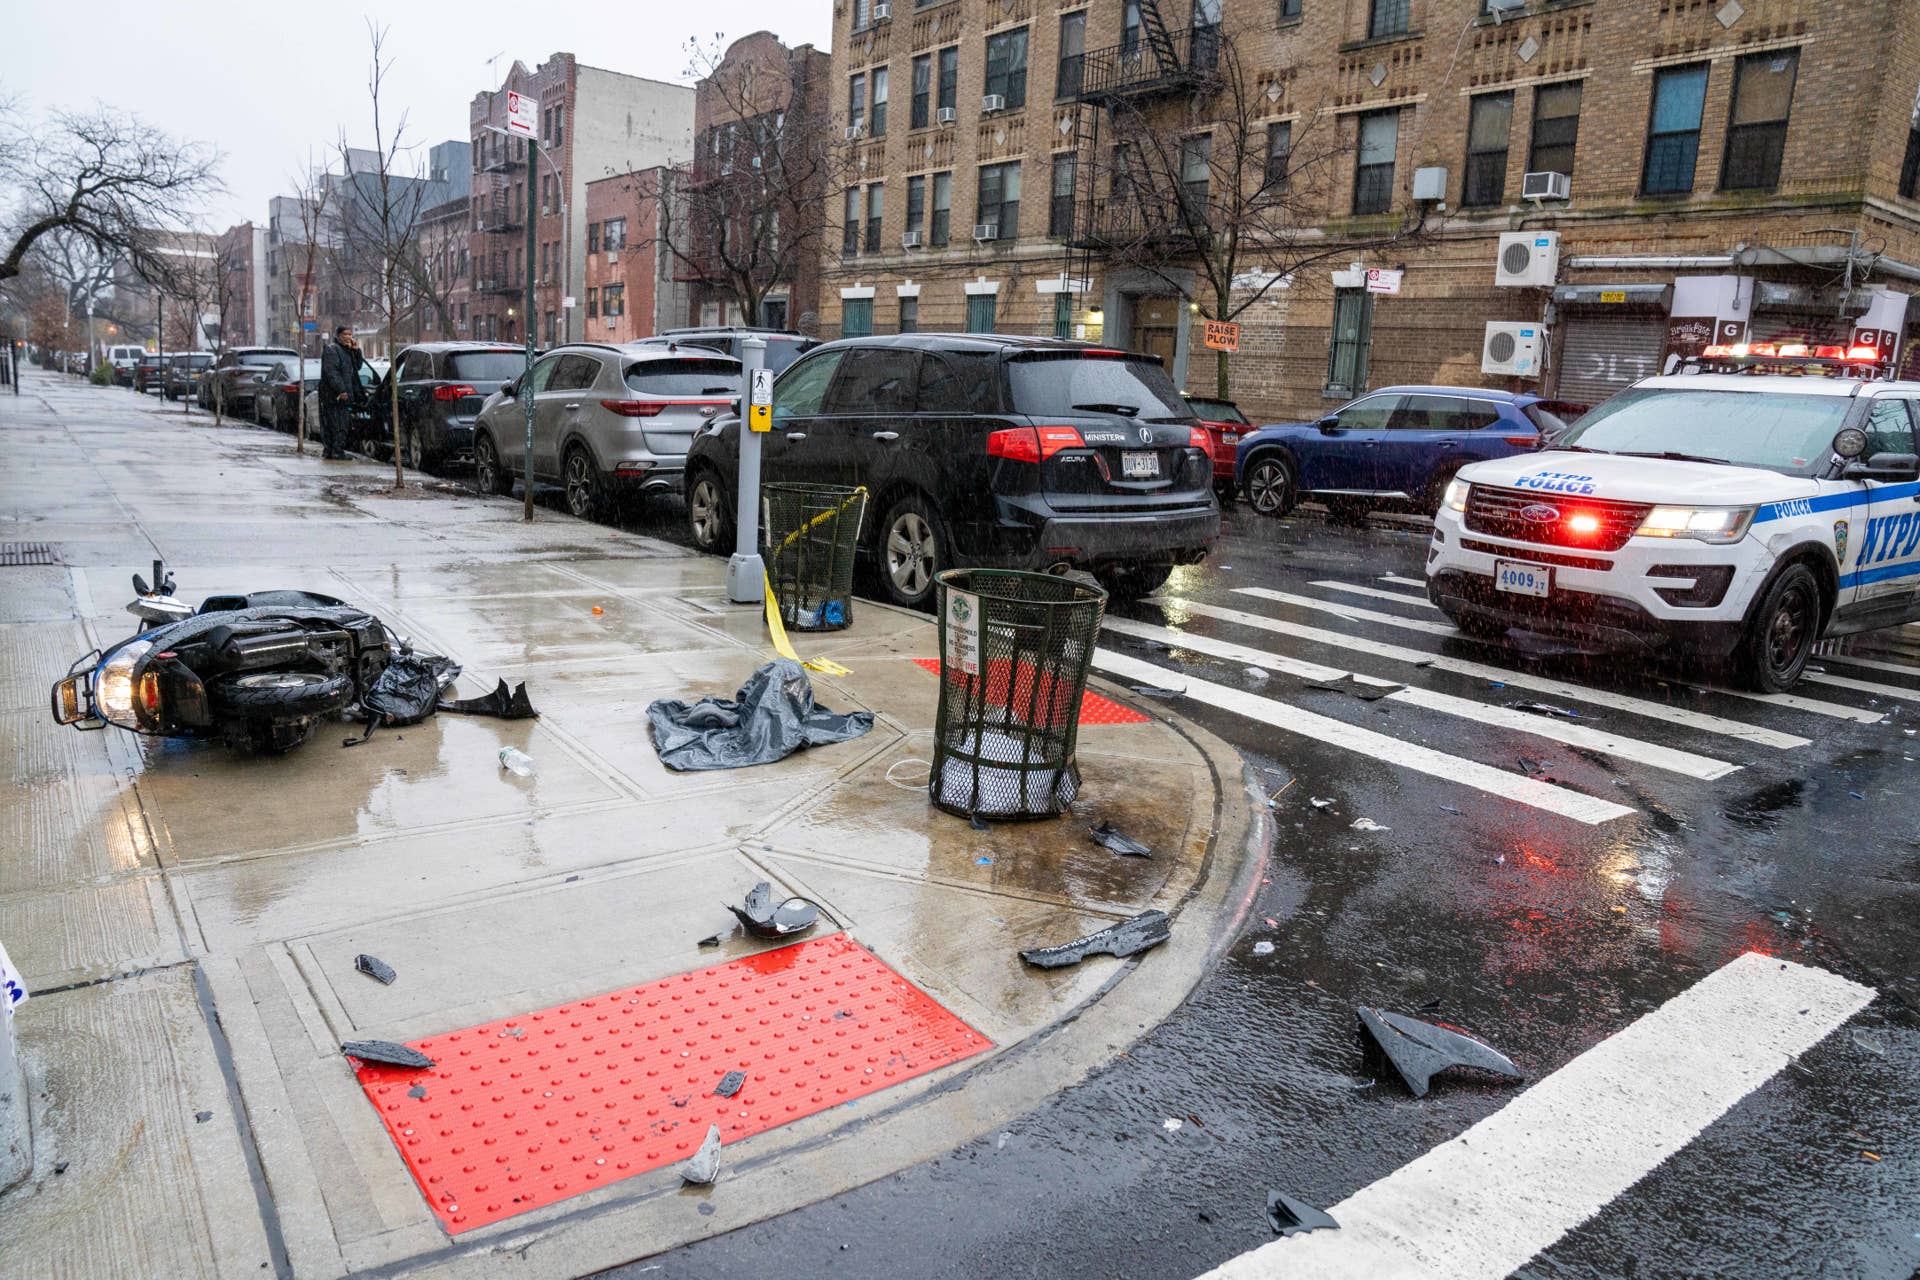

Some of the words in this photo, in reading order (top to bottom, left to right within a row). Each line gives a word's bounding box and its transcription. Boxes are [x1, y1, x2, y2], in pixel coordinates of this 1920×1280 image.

[1207, 324, 1236, 336] RAISE
[1724, 324, 1737, 336] G
[1207, 334, 1236, 345] PLOW
[1860, 332, 1874, 344] G
[1084, 433, 1122, 442] MINISTER
[1536, 471, 1593, 482] NYPD
[1514, 477, 1597, 495] POLICE
[1776, 499, 1811, 519] POLICE
[1855, 511, 1920, 567] NYPD
[1501, 570, 1534, 588] 4009
